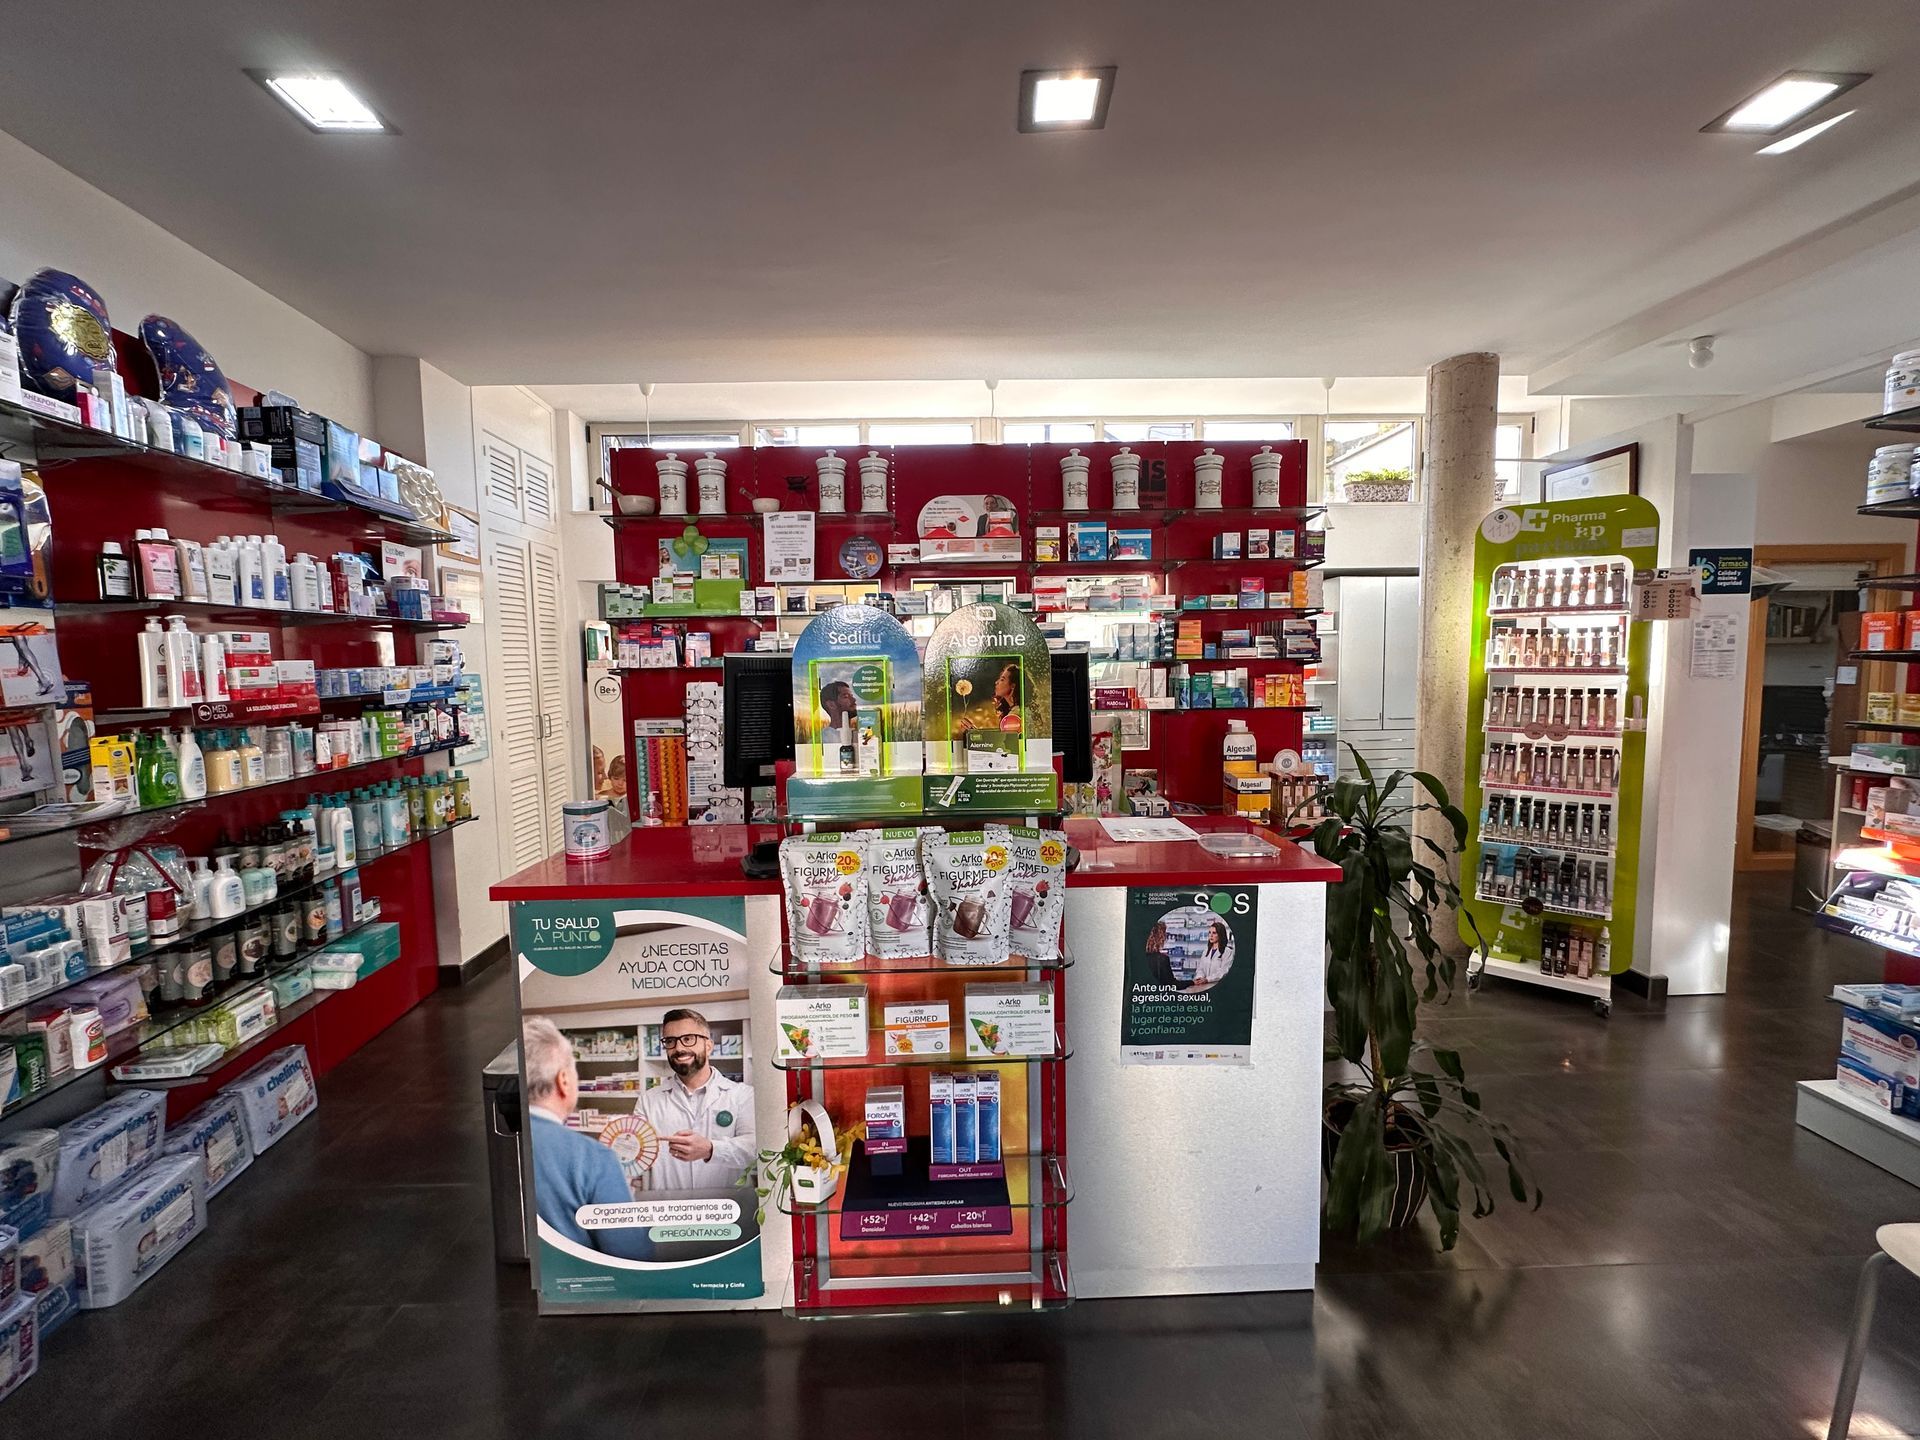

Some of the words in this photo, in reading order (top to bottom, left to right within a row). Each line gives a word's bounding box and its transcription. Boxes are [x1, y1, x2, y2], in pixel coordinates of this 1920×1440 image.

[23, 393, 56, 407] XHEKPON
[1553, 512, 1606, 523] Pharma
[829, 631, 882, 644] Sediflu
[950, 631, 1026, 647] Alernine
[600, 686, 616, 694] Be+
[1012, 828, 1037, 838] NUEVO
[816, 851, 837, 860] Arko
[894, 848, 915, 857] Arko
[1014, 846, 1036, 857] Arko
[1041, 846, 1063, 856] 20%
[837, 856, 860, 866] 20%
[961, 854, 982, 863] Arko
[872, 864, 924, 874] FIGURME
[939, 869, 997, 880] FIGURMED
[804, 874, 840, 886] Shake
[883, 871, 919, 884] Shake
[951, 878, 986, 890] Shake
[1194, 893, 1250, 914] SOS
[531, 918, 551, 930] TU
[555, 917, 600, 930] SALUD
[534, 932, 544, 943] A
[641, 942, 729, 958] ¿NECESITAS
[618, 961, 667, 974] AYUDA
[673, 960, 706, 972] CON
[711, 959, 729, 971] TU
[632, 974, 730, 990] MEDICACIÓN?
[1132, 983, 1157, 992] Ante
[1132, 993, 1176, 1004] agresión
[1177, 992, 1210, 1002] sexual,
[1142, 1004, 1185, 1012] farmacia
[1132, 1016, 1156, 1026] lugar
[1173, 1016, 1204, 1024] apoyo
[1131, 1028, 1137, 1036] y
[1138, 1025, 1186, 1034] confianza
[267, 1059, 302, 1092] chelino
[192, 1111, 232, 1149] chelino
[141, 1183, 186, 1223] chelino
[593, 1206, 649, 1218] Organizamos
[668, 1203, 718, 1212] tratamientos
[602, 1216, 634, 1224] manera
[658, 1212, 692, 1222] cómoda
[696, 1215, 701, 1223] y
[705, 1212, 732, 1223] segura
[660, 1227, 732, 1238] ¡PREGÚNTANOS!
